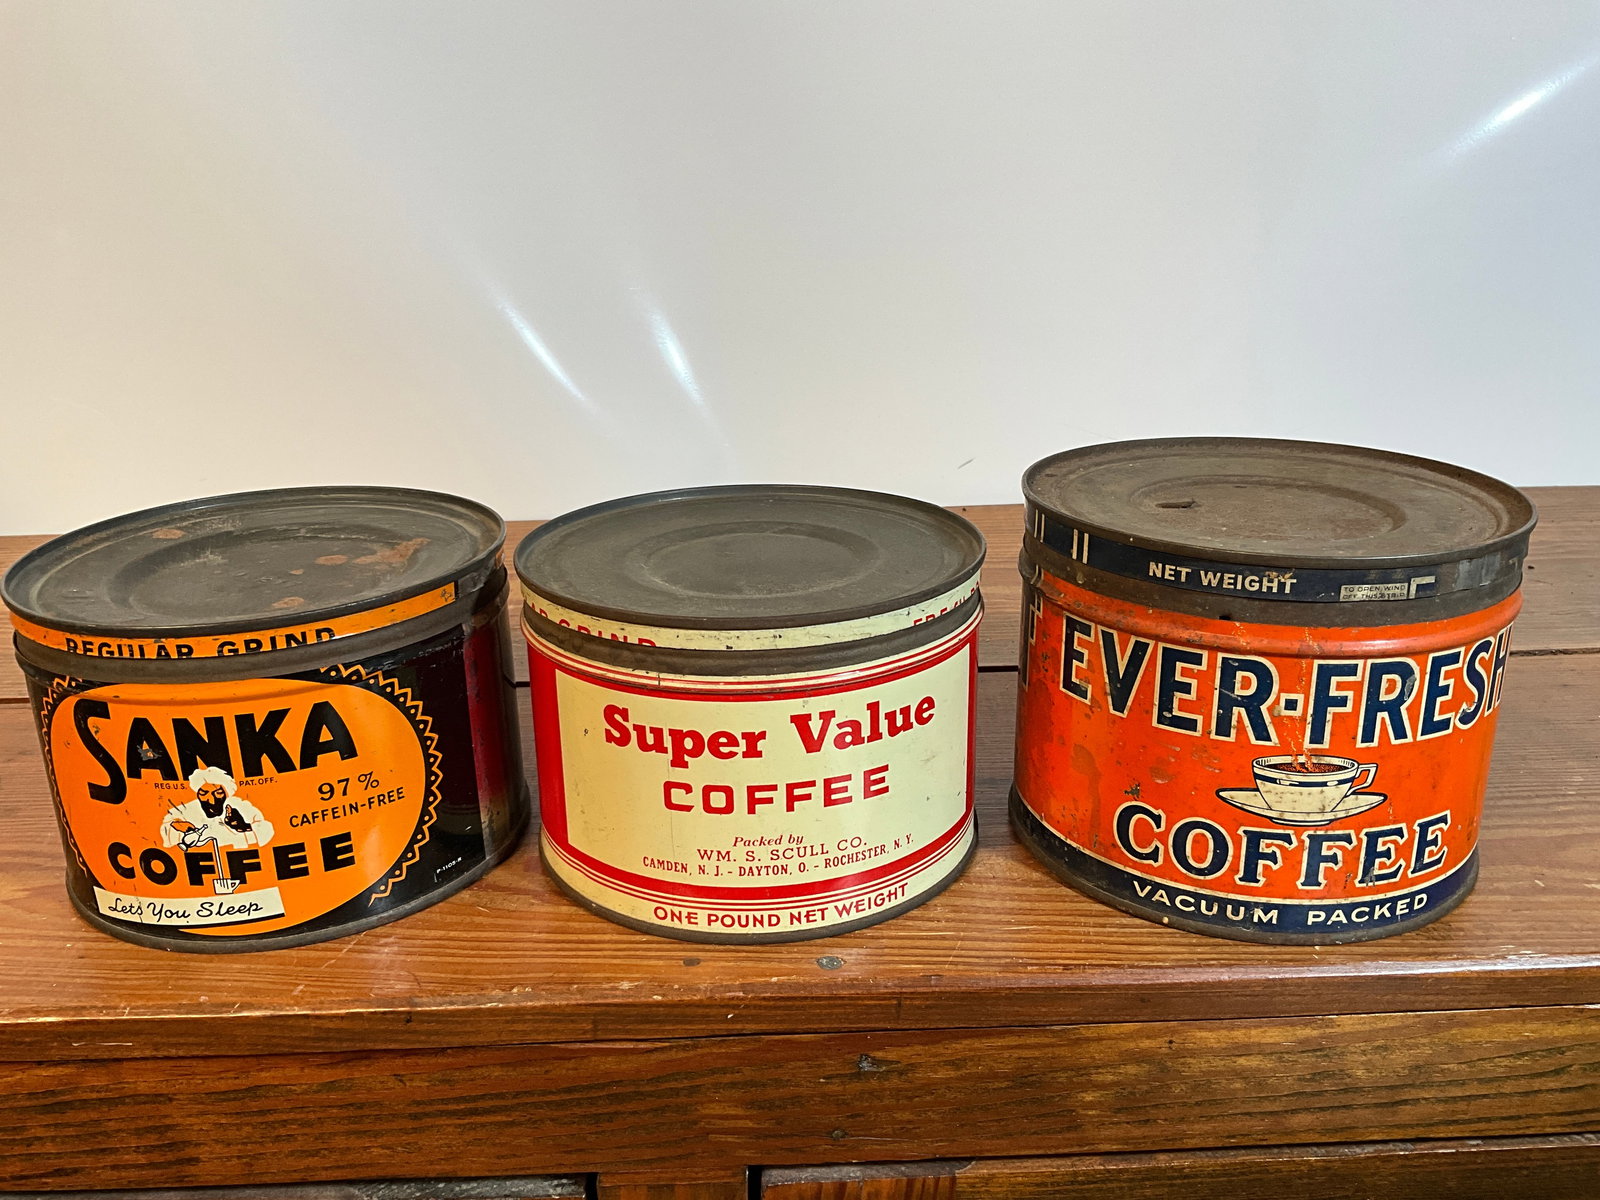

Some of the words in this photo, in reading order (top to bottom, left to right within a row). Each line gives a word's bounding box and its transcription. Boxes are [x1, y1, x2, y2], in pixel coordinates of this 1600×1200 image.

[1148, 561, 1192, 583] NET
[1199, 570, 1297, 594] WEIGHT
[1357, 585, 1381, 593] OPEN
[1384, 584, 1406, 592] WIND
[1059, 611, 1514, 748] EVER-FRESH
[73, 698, 358, 805] SANKA
[603, 704, 767, 768] Super
[789, 695, 936, 753] Value
[289, 786, 406, 828] CAFFEIN-FREE
[317, 776, 351, 802] 97
[357, 770, 380, 791] %
[663, 764, 890, 815] COFFEE
[107, 831, 356, 886] COFFEE
[643, 856, 692, 876] CAMDEN,
[738, 863, 792, 877] DAYTON,
[893, 838, 903, 850] N.
[905, 833, 914, 845] Y.
[697, 848, 737, 862] WM.
[745, 850, 762, 862] S.
[770, 843, 829, 861] SCULL
[837, 836, 867, 851] CO.
[732, 834, 783, 848] Packed
[788, 833, 804, 846] by
[1112, 801, 1452, 890] COFFEE
[146, 902, 191, 923] You
[196, 900, 264, 918] Sleep
[653, 905, 699, 926] ONE
[706, 913, 781, 929] POUND
[789, 906, 829, 926] NET
[834, 882, 909, 919] WEIGHT
[1132, 880, 1279, 925] VACUUM
[1306, 892, 1429, 926] PACKED
